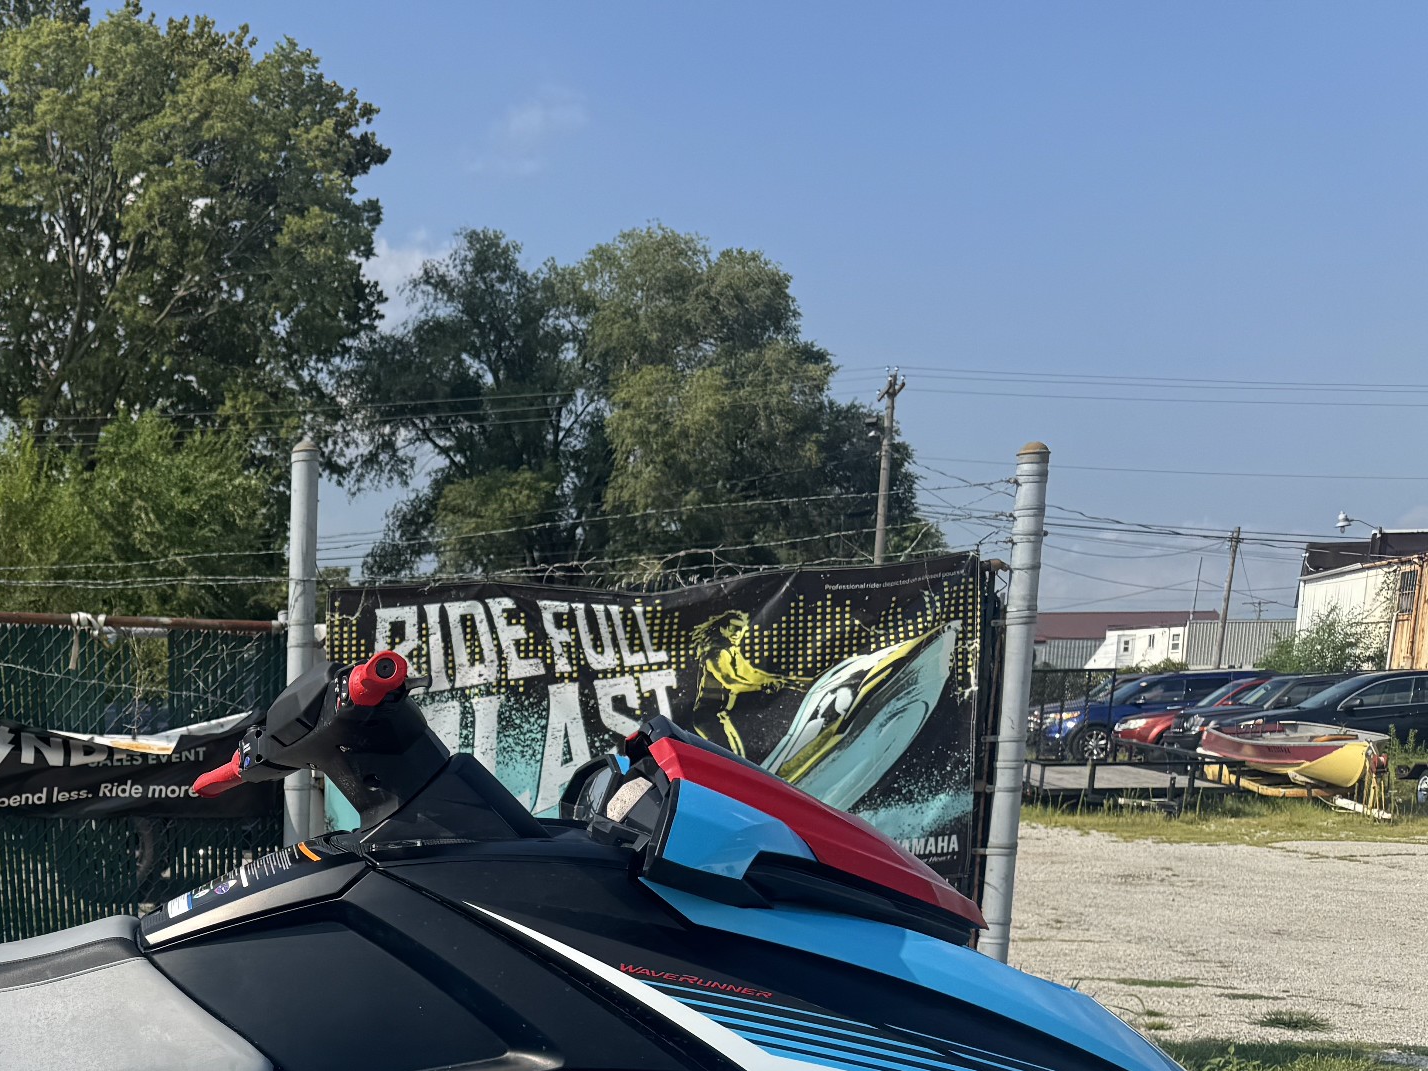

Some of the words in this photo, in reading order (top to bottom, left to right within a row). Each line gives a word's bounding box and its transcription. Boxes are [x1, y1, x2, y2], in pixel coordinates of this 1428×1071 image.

[374, 597, 546, 696] RIDE
[536, 599, 669, 670] FULL
[148, 747, 207, 765] EVENT
[419, 668, 677, 818] LAST
[52, 786, 93, 804] less.
[98, 779, 143, 798] Ride
[896, 834, 959, 856] AMAHA
[619, 962, 773, 999] WAVERUNNER
